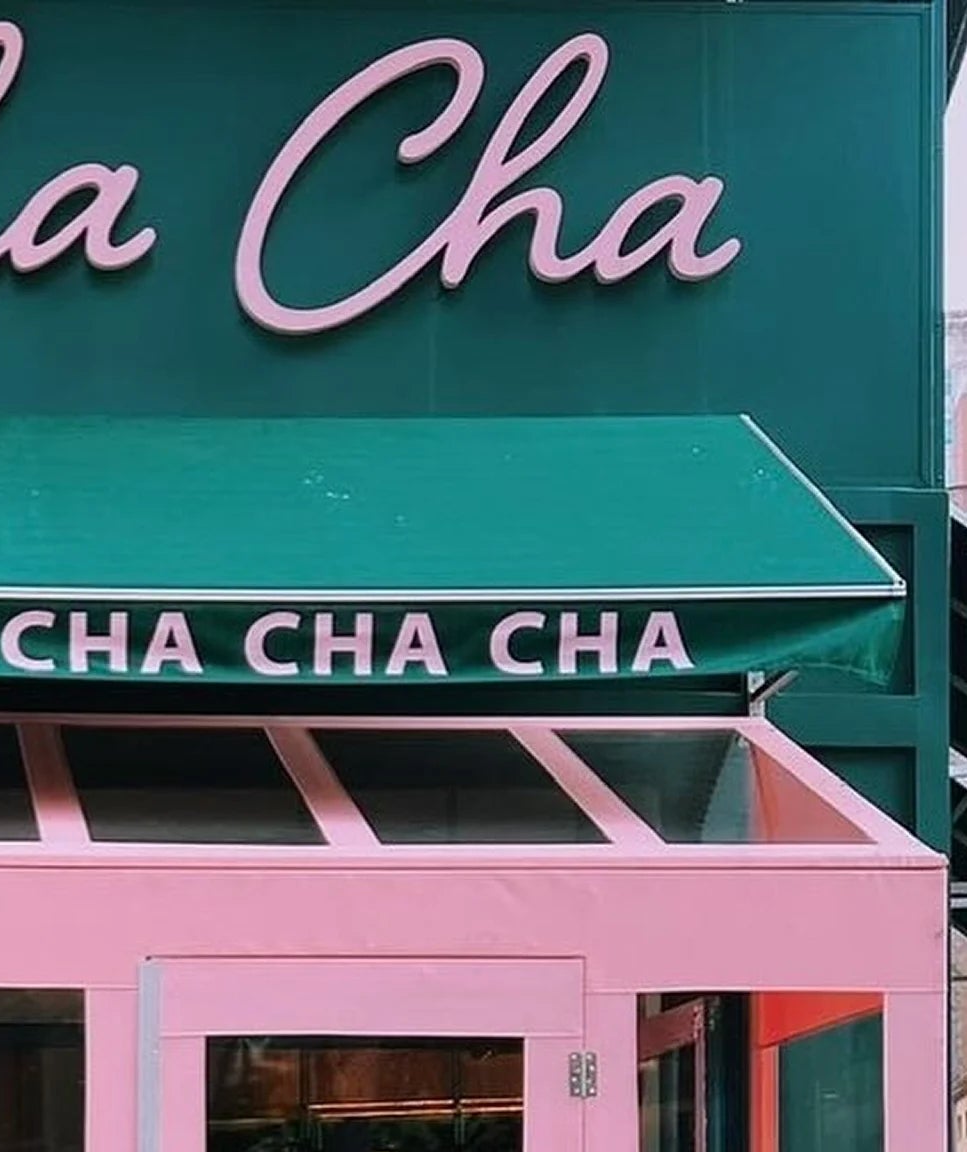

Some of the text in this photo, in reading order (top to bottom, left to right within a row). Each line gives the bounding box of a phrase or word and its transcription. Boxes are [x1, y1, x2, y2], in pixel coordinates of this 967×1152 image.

[235, 34, 741, 335] Cha
[0, 610, 693, 677] CHA CHA CHA
